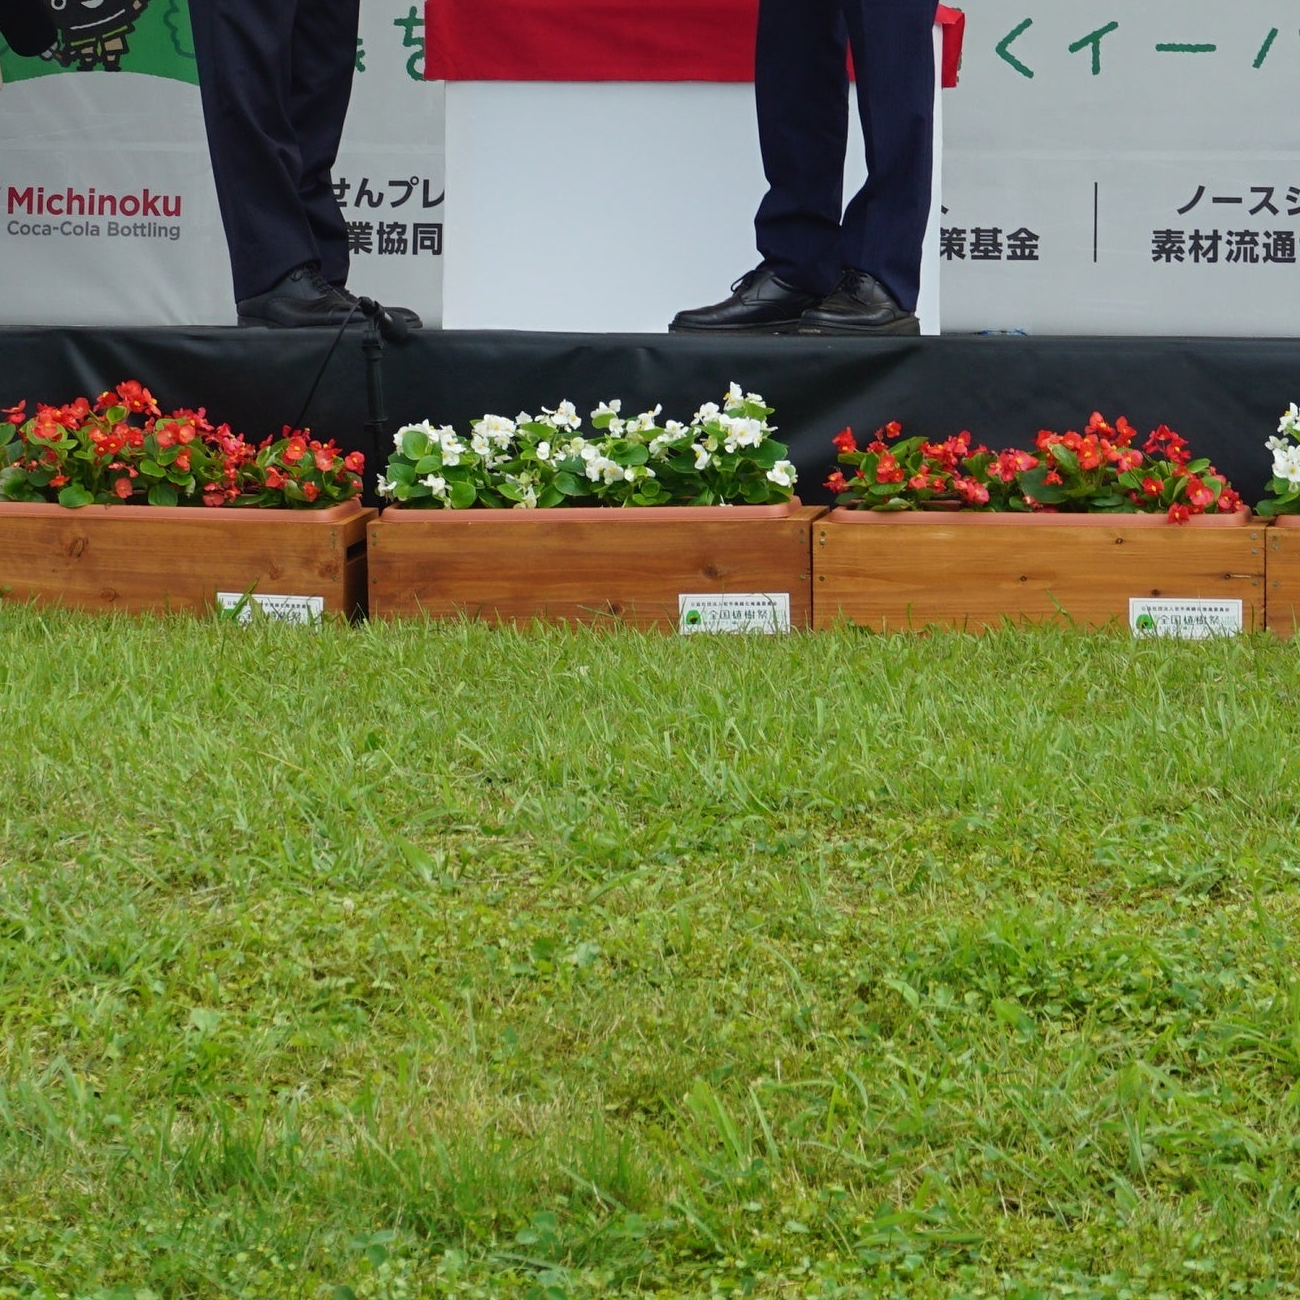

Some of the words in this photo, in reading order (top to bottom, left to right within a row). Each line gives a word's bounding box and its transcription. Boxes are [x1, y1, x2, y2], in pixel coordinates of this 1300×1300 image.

[7, 187, 182, 217] Michinoku
[7, 221, 100, 237] Coca-Cola
[107, 221, 181, 240] Bottling
